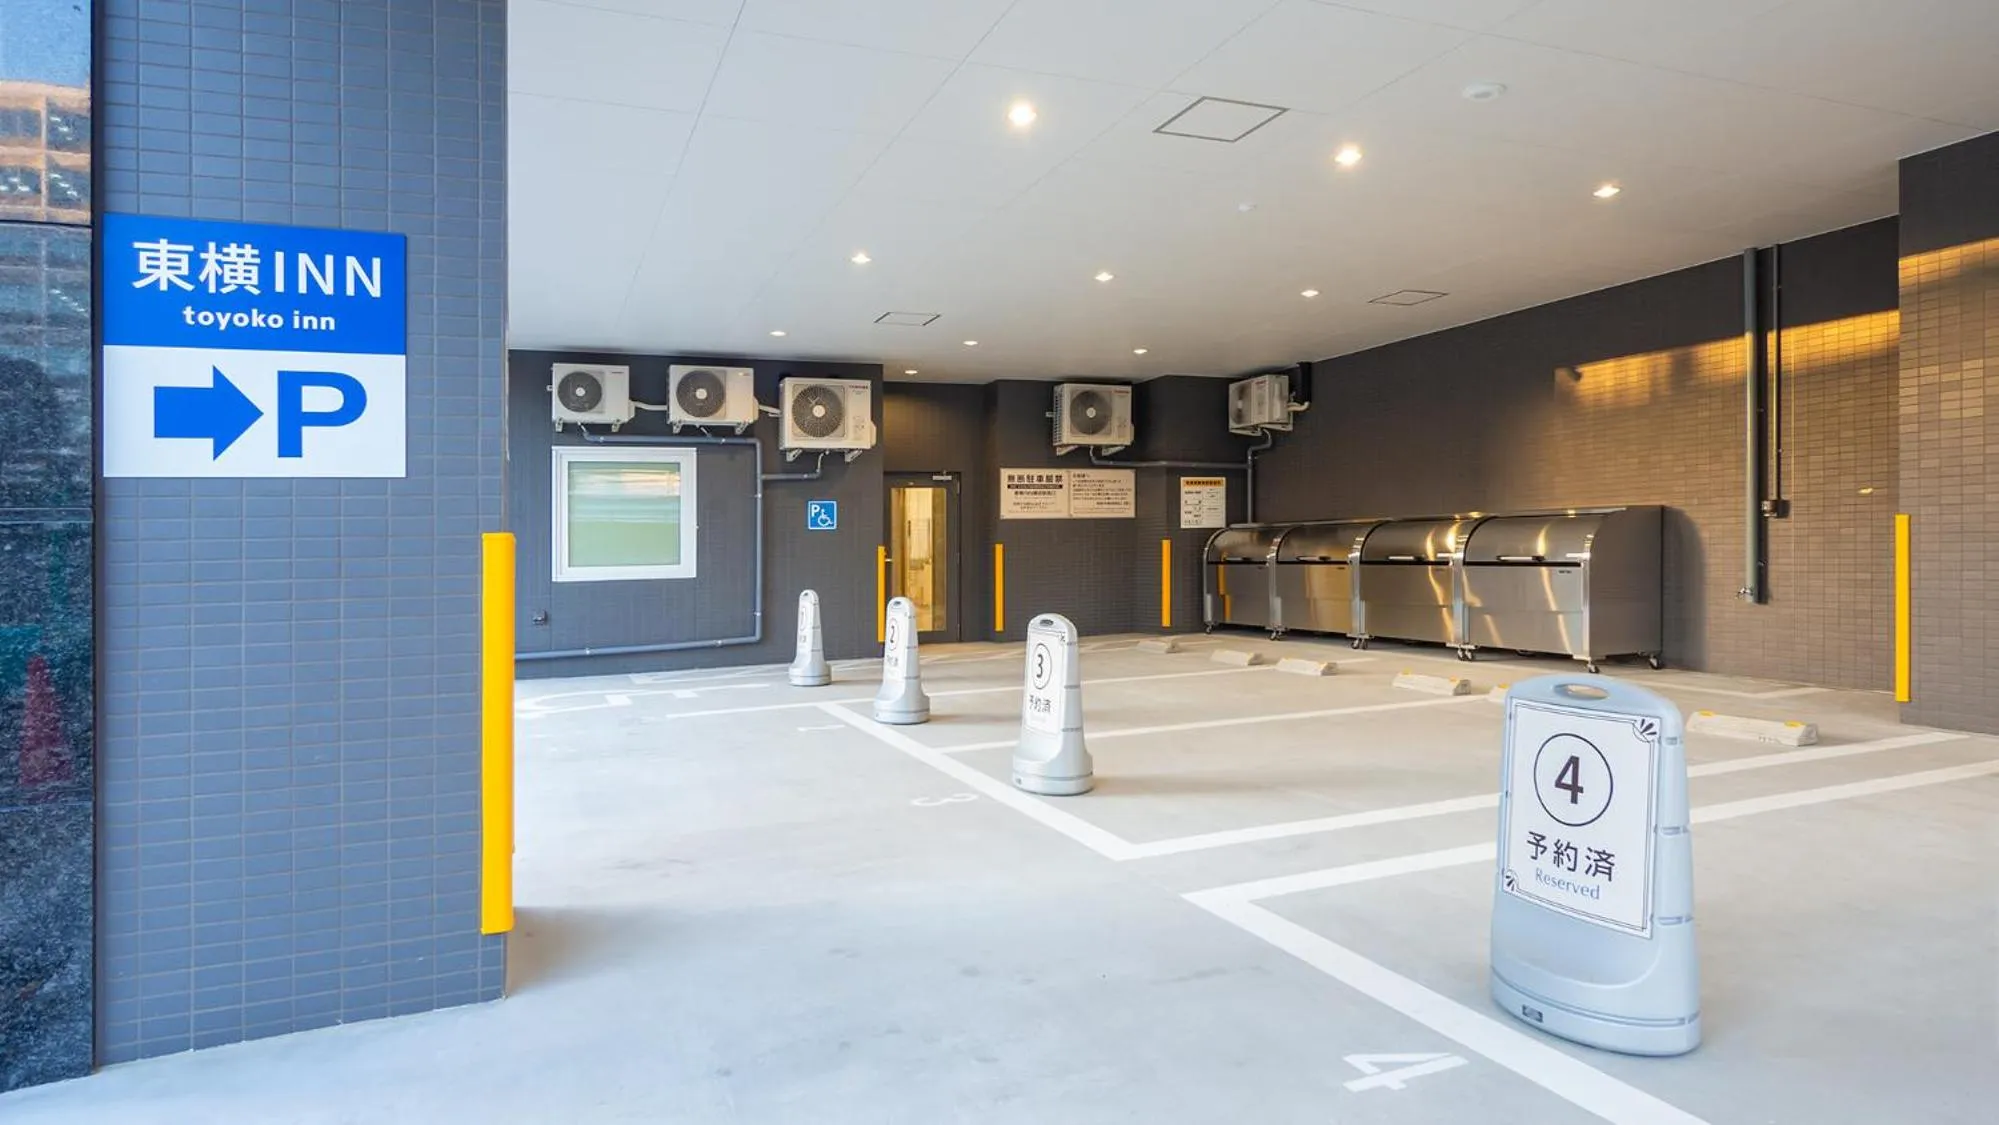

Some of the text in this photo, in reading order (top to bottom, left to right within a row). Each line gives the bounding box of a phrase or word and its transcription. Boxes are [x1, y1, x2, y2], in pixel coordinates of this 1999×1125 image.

[132, 238, 382, 298] 東横INN
[182, 305, 336, 332] toyoko inn
[277, 370, 368, 459] P
[812, 505, 820, 517] P
[1036, 654, 1044, 679] 3
[1554, 754, 1585, 806] 4
[910, 792, 979, 807] 3
[1526, 830, 1617, 883] 予約済
[1535, 867, 1601, 900] Reserved
[1342, 1052, 1469, 1093] 4
